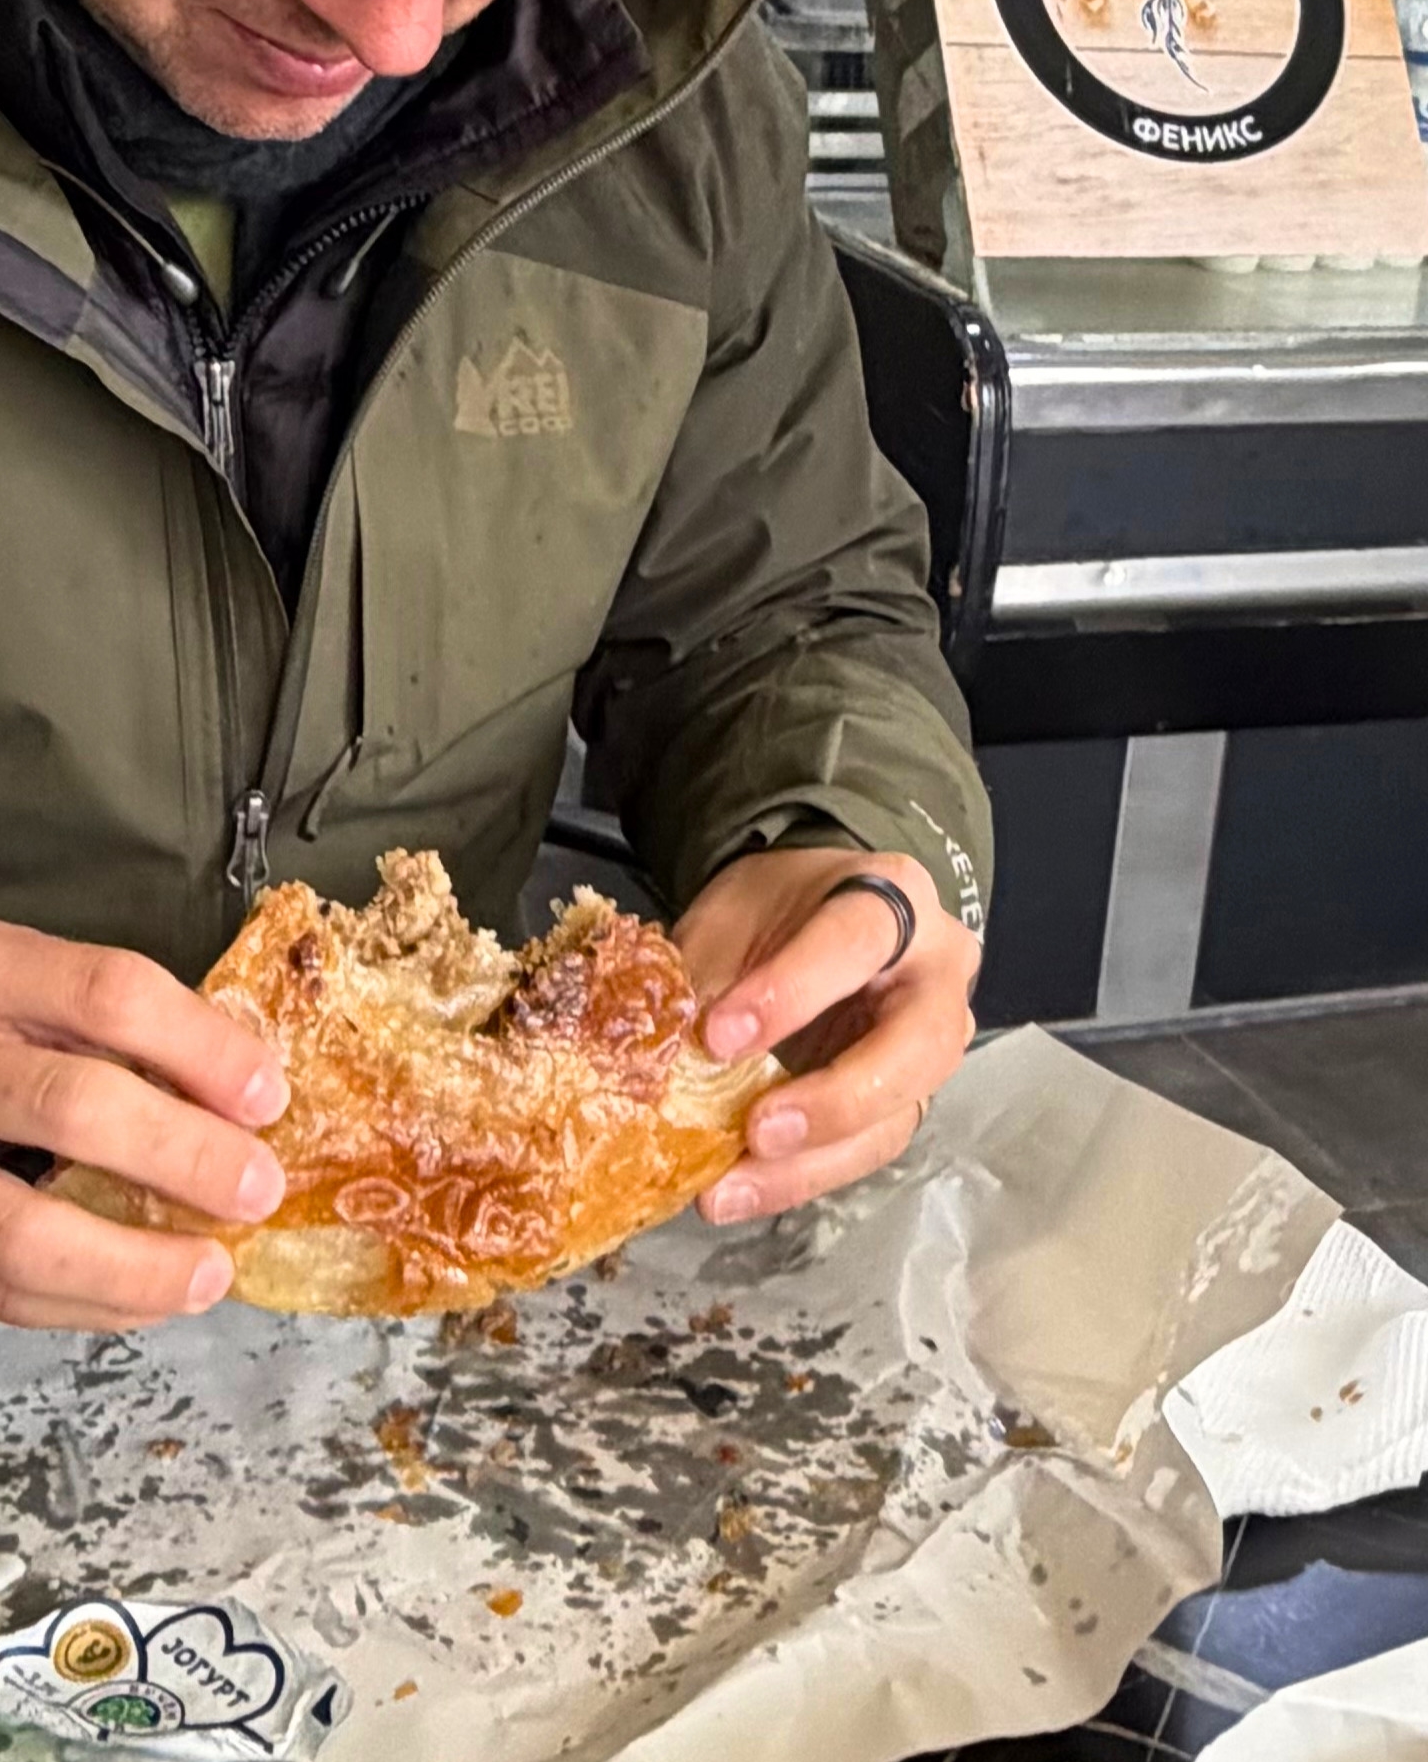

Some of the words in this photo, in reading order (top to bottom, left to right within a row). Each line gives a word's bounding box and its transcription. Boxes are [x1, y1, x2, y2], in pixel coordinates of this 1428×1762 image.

[1131, 114, 1264, 153] ФЕНИКС
[497, 371, 571, 416] REI
[160, 1635, 252, 1708] ЈОГУРТ
